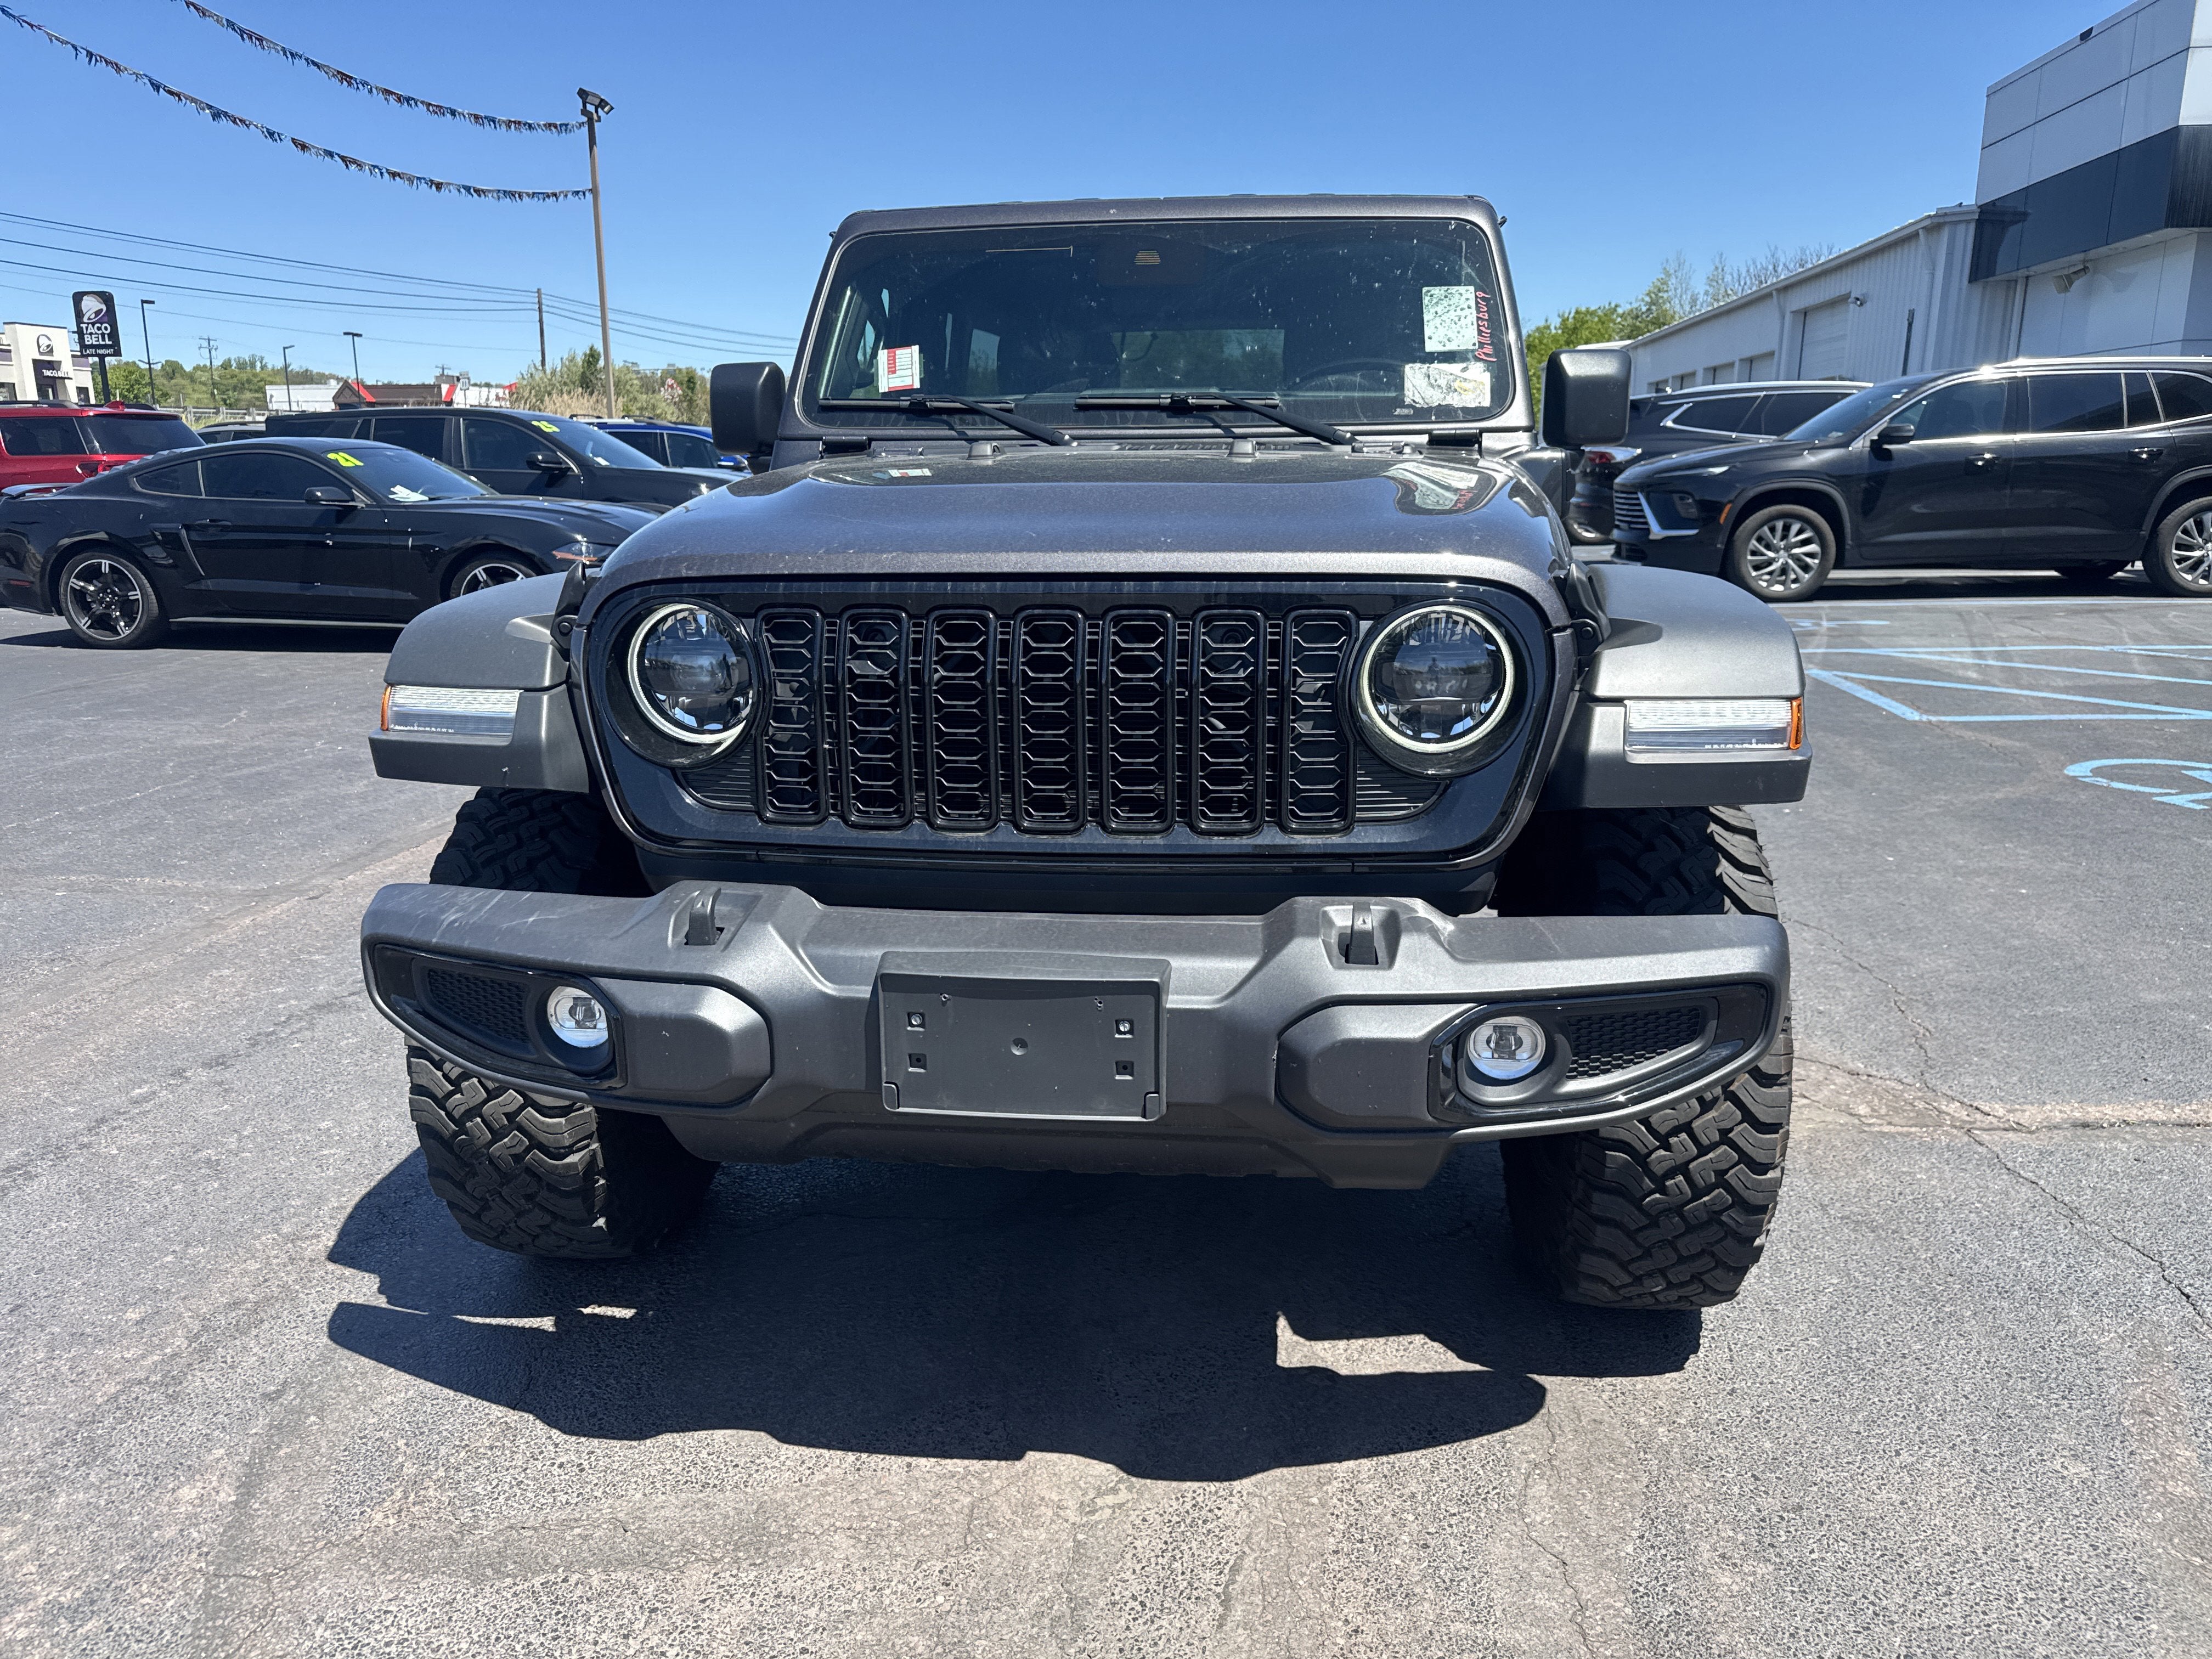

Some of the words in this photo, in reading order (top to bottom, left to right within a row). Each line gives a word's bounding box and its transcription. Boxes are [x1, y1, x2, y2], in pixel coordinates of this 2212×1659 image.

[80, 324, 111, 334] TACO
[84, 334, 112, 345] BELL
[327, 452, 364, 467] 21
